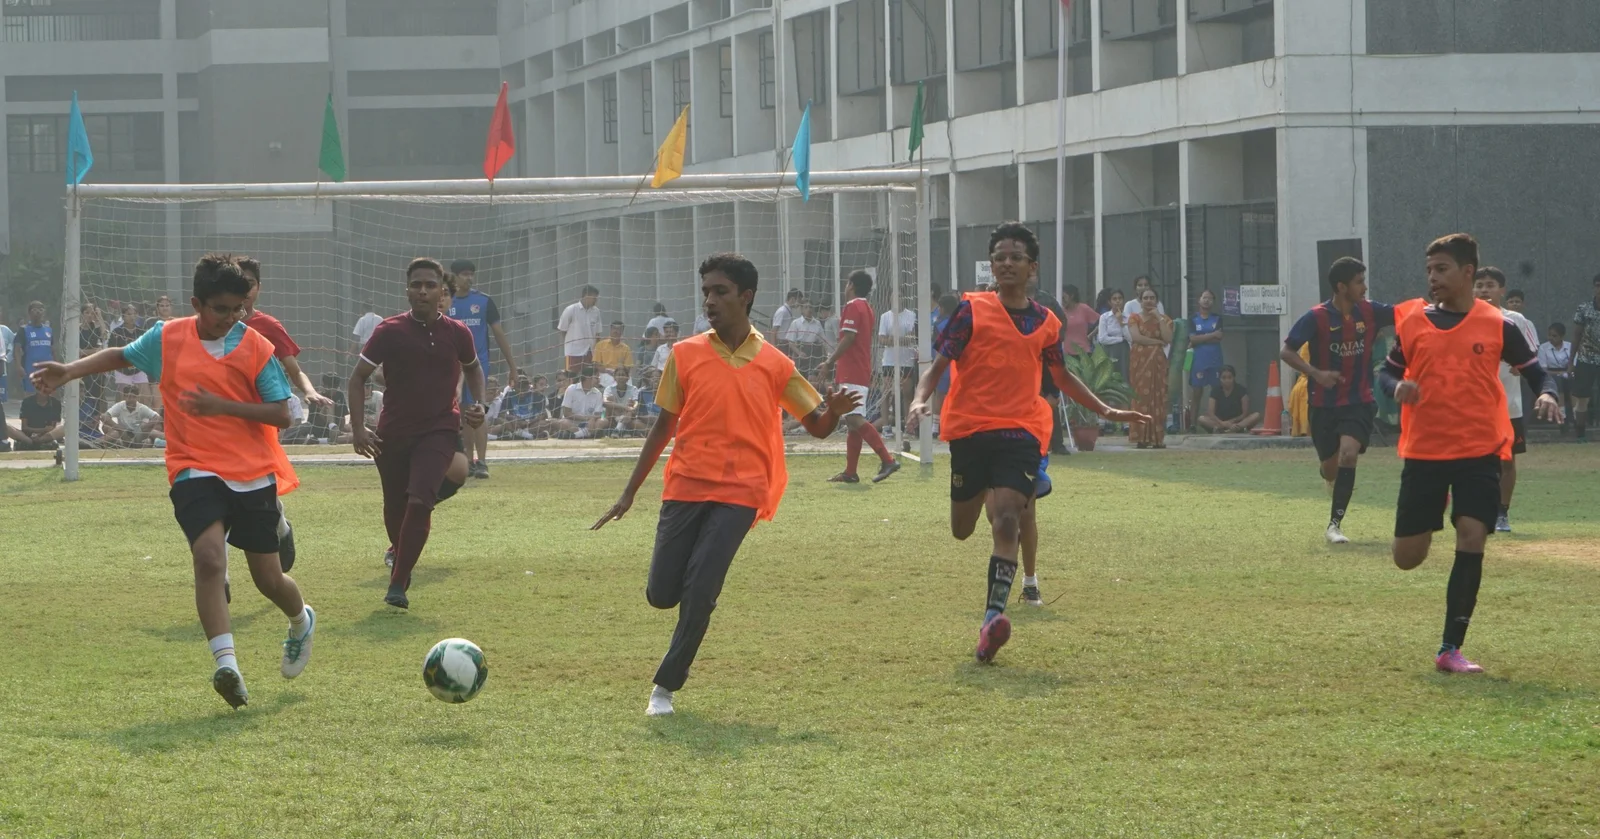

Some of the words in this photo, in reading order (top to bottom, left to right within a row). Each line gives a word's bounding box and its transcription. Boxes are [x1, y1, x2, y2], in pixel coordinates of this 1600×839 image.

[1241, 286, 1260, 298] Football
[1261, 286, 1280, 298] Ground
[1244, 302, 1262, 313] Cricket
[1262, 302, 1276, 313] Pitch
